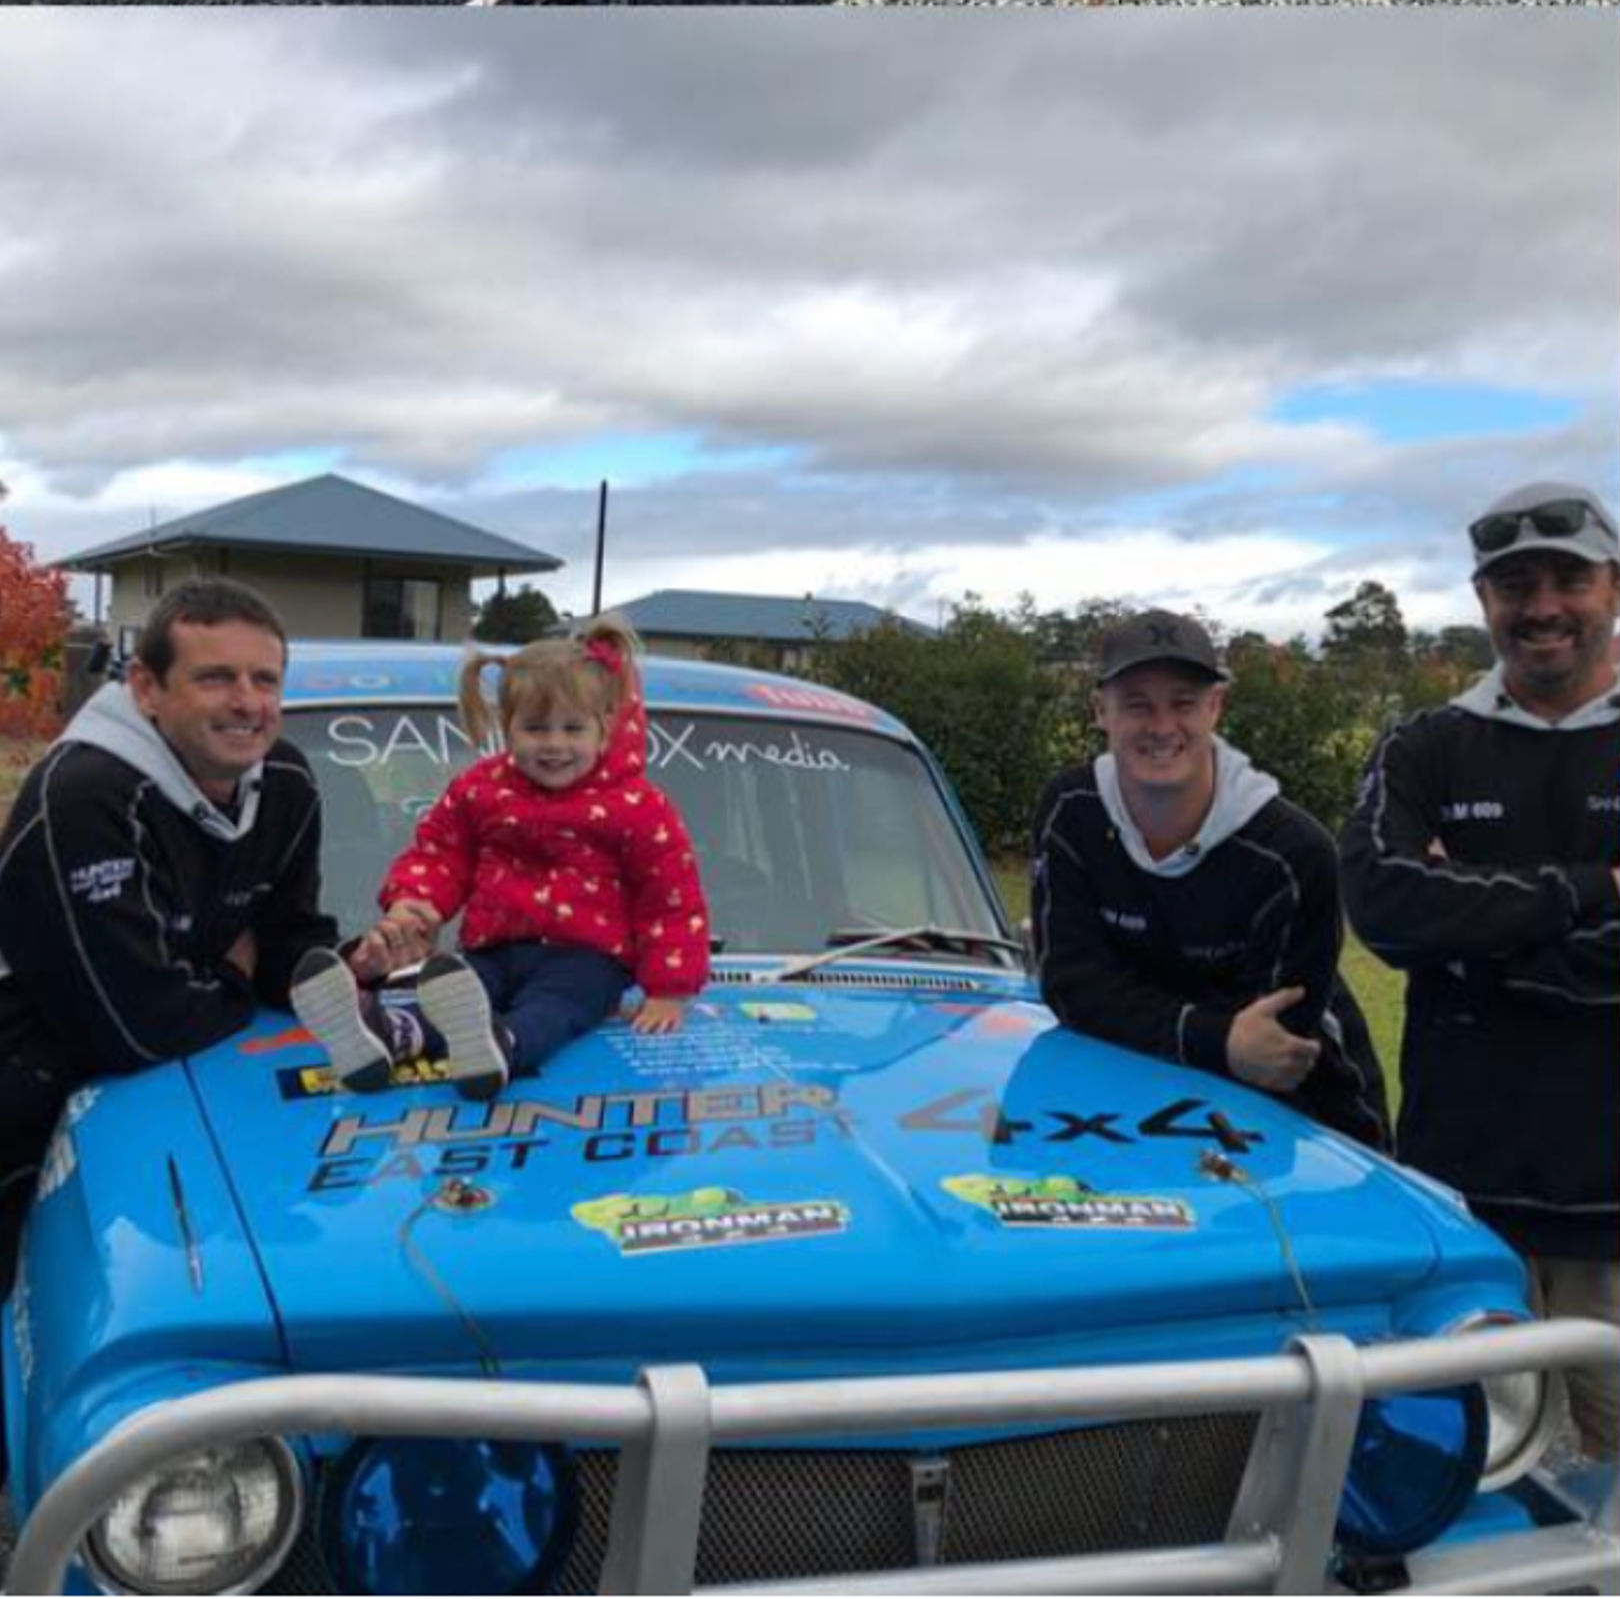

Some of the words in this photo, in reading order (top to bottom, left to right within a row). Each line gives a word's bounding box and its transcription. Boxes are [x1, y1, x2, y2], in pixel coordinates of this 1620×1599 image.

[306, 1137, 550, 1193] EAST
[583, 1113, 862, 1163] COAST
[318, 1082, 840, 1158] HUNTER
[623, 1205, 831, 1239] IRONMAN
